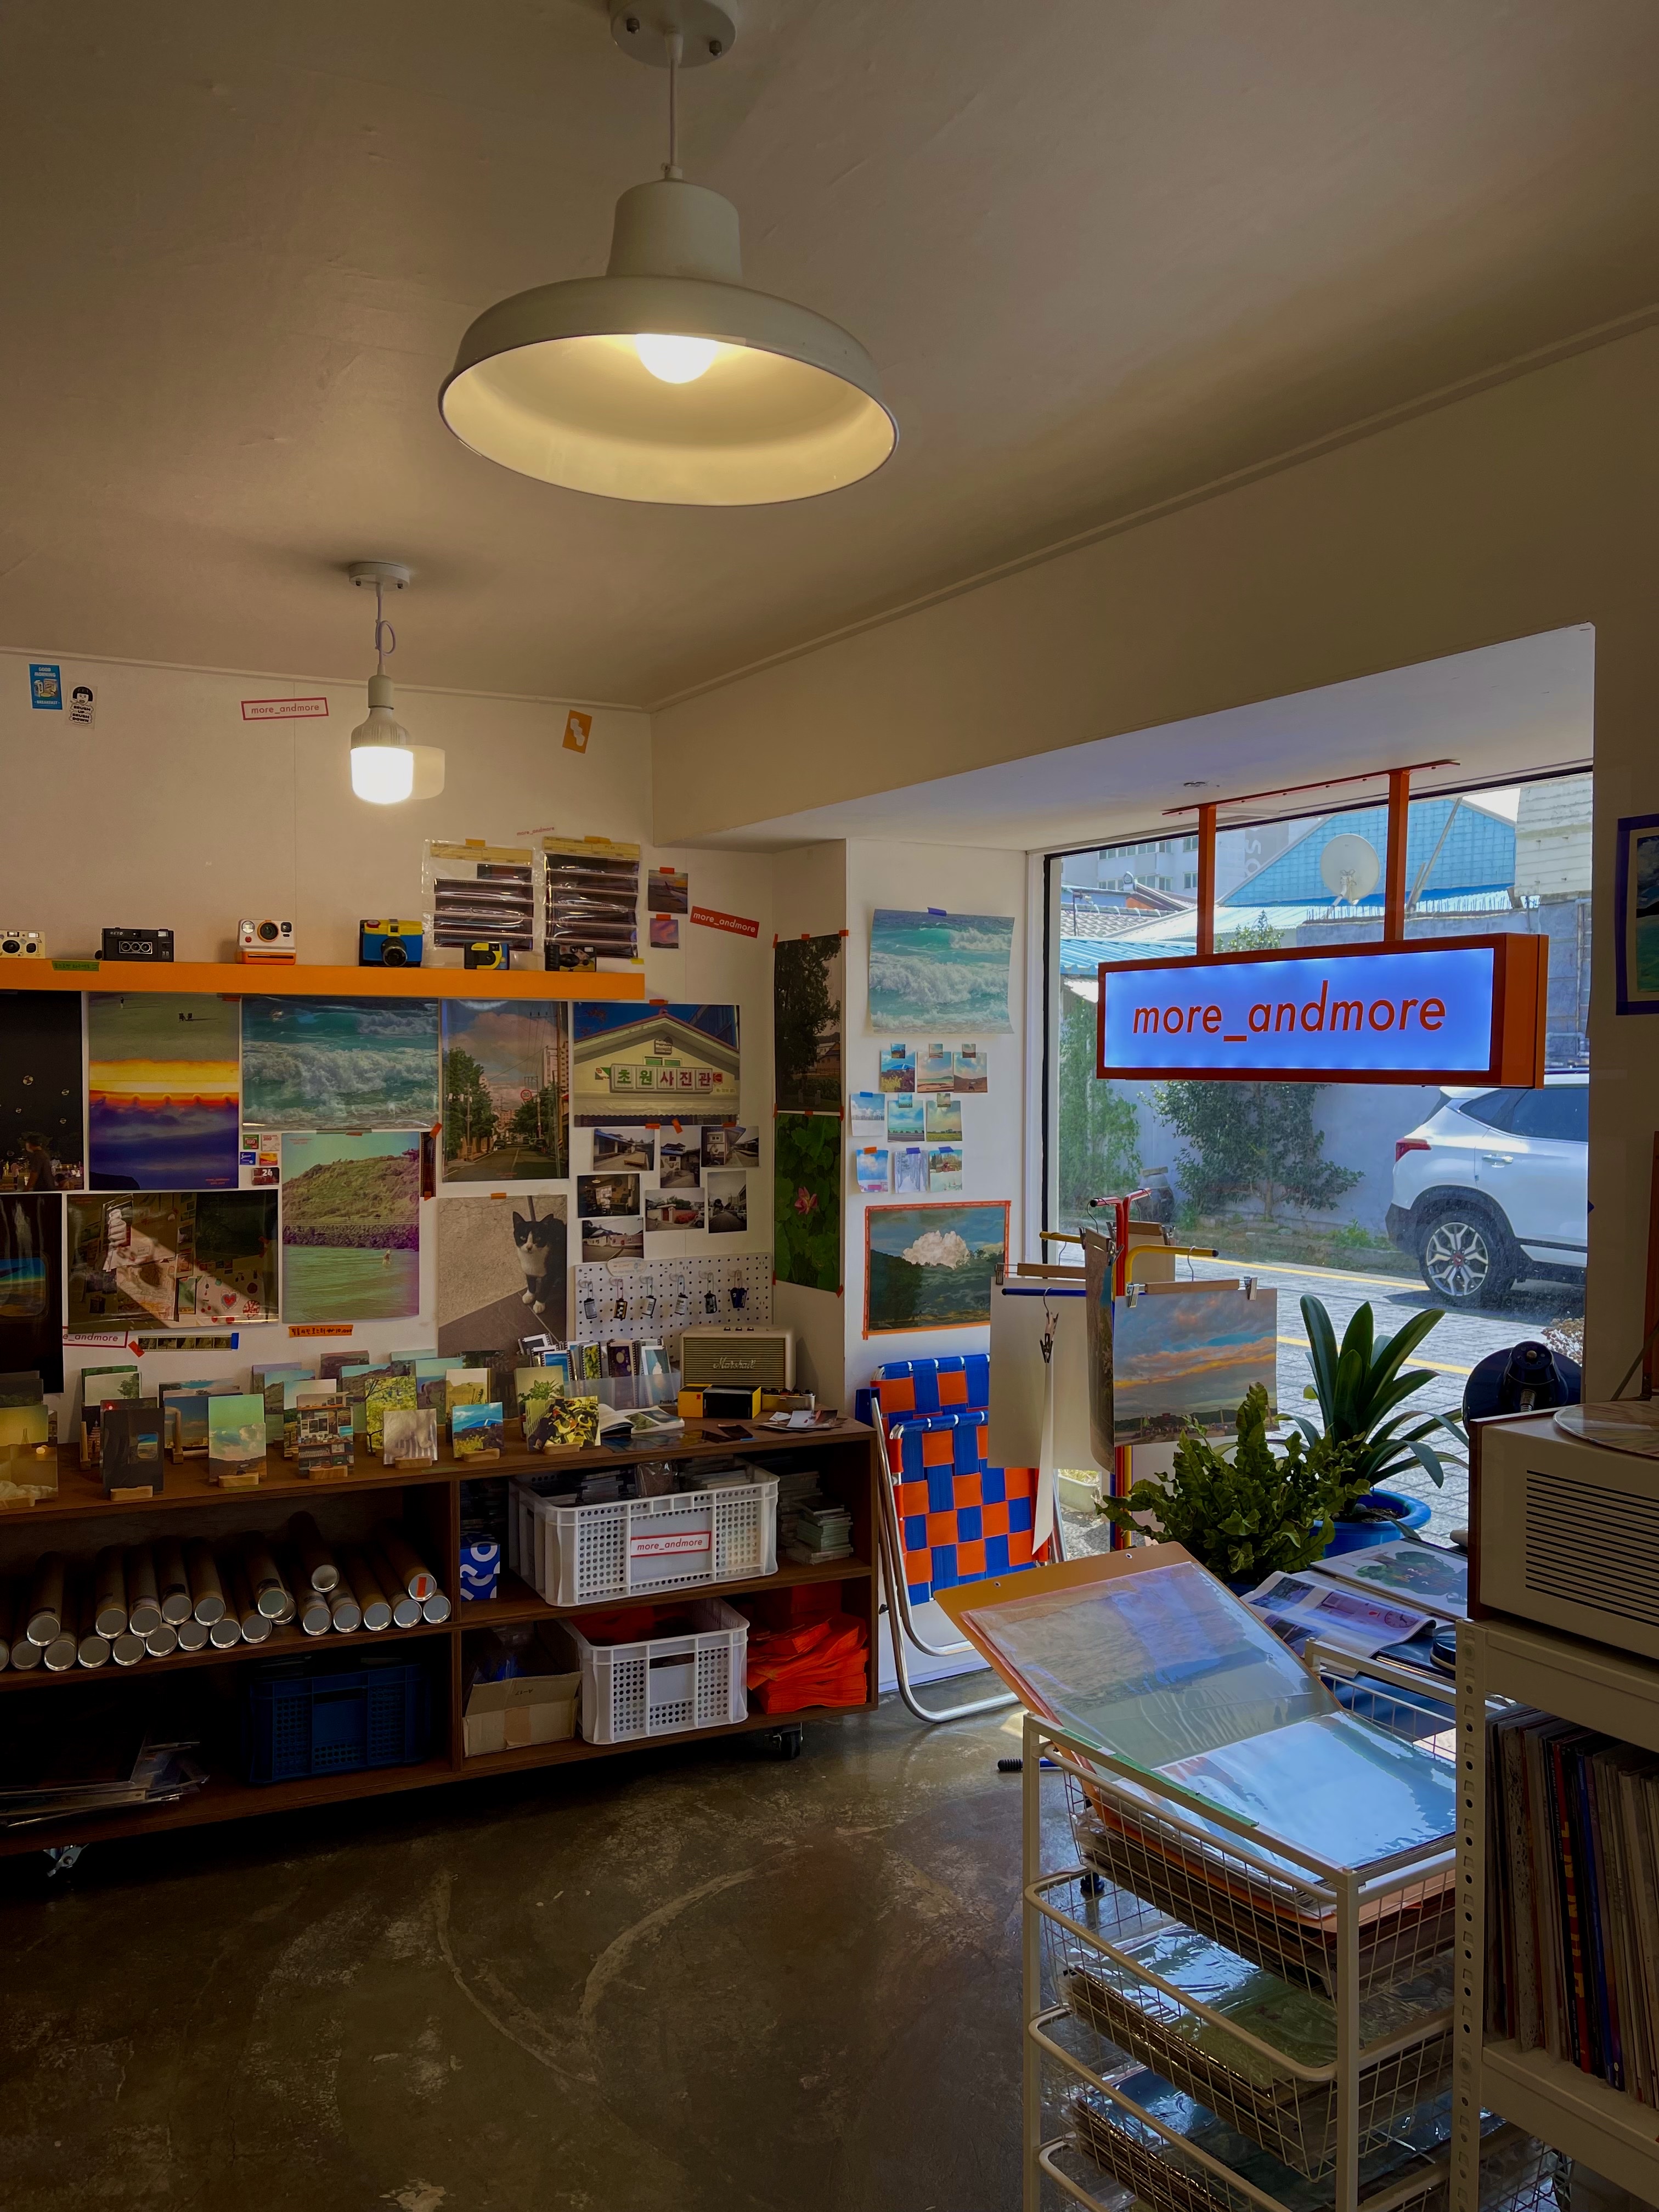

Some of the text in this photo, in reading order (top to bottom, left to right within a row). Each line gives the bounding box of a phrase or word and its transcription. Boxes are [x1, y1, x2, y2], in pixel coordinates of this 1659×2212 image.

[251, 703, 319, 714] more_andmore
[517, 827, 555, 836] more_andmore
[693, 912, 756, 933] more_andmore
[1132, 979, 1446, 1042] more_andmore
[617, 1069, 712, 1086] 초원사진관
[63, 1333, 119, 1341] e_andmore
[713, 1357, 756, 1369] Marshall
[637, 1538, 703, 1550] more_andmore
